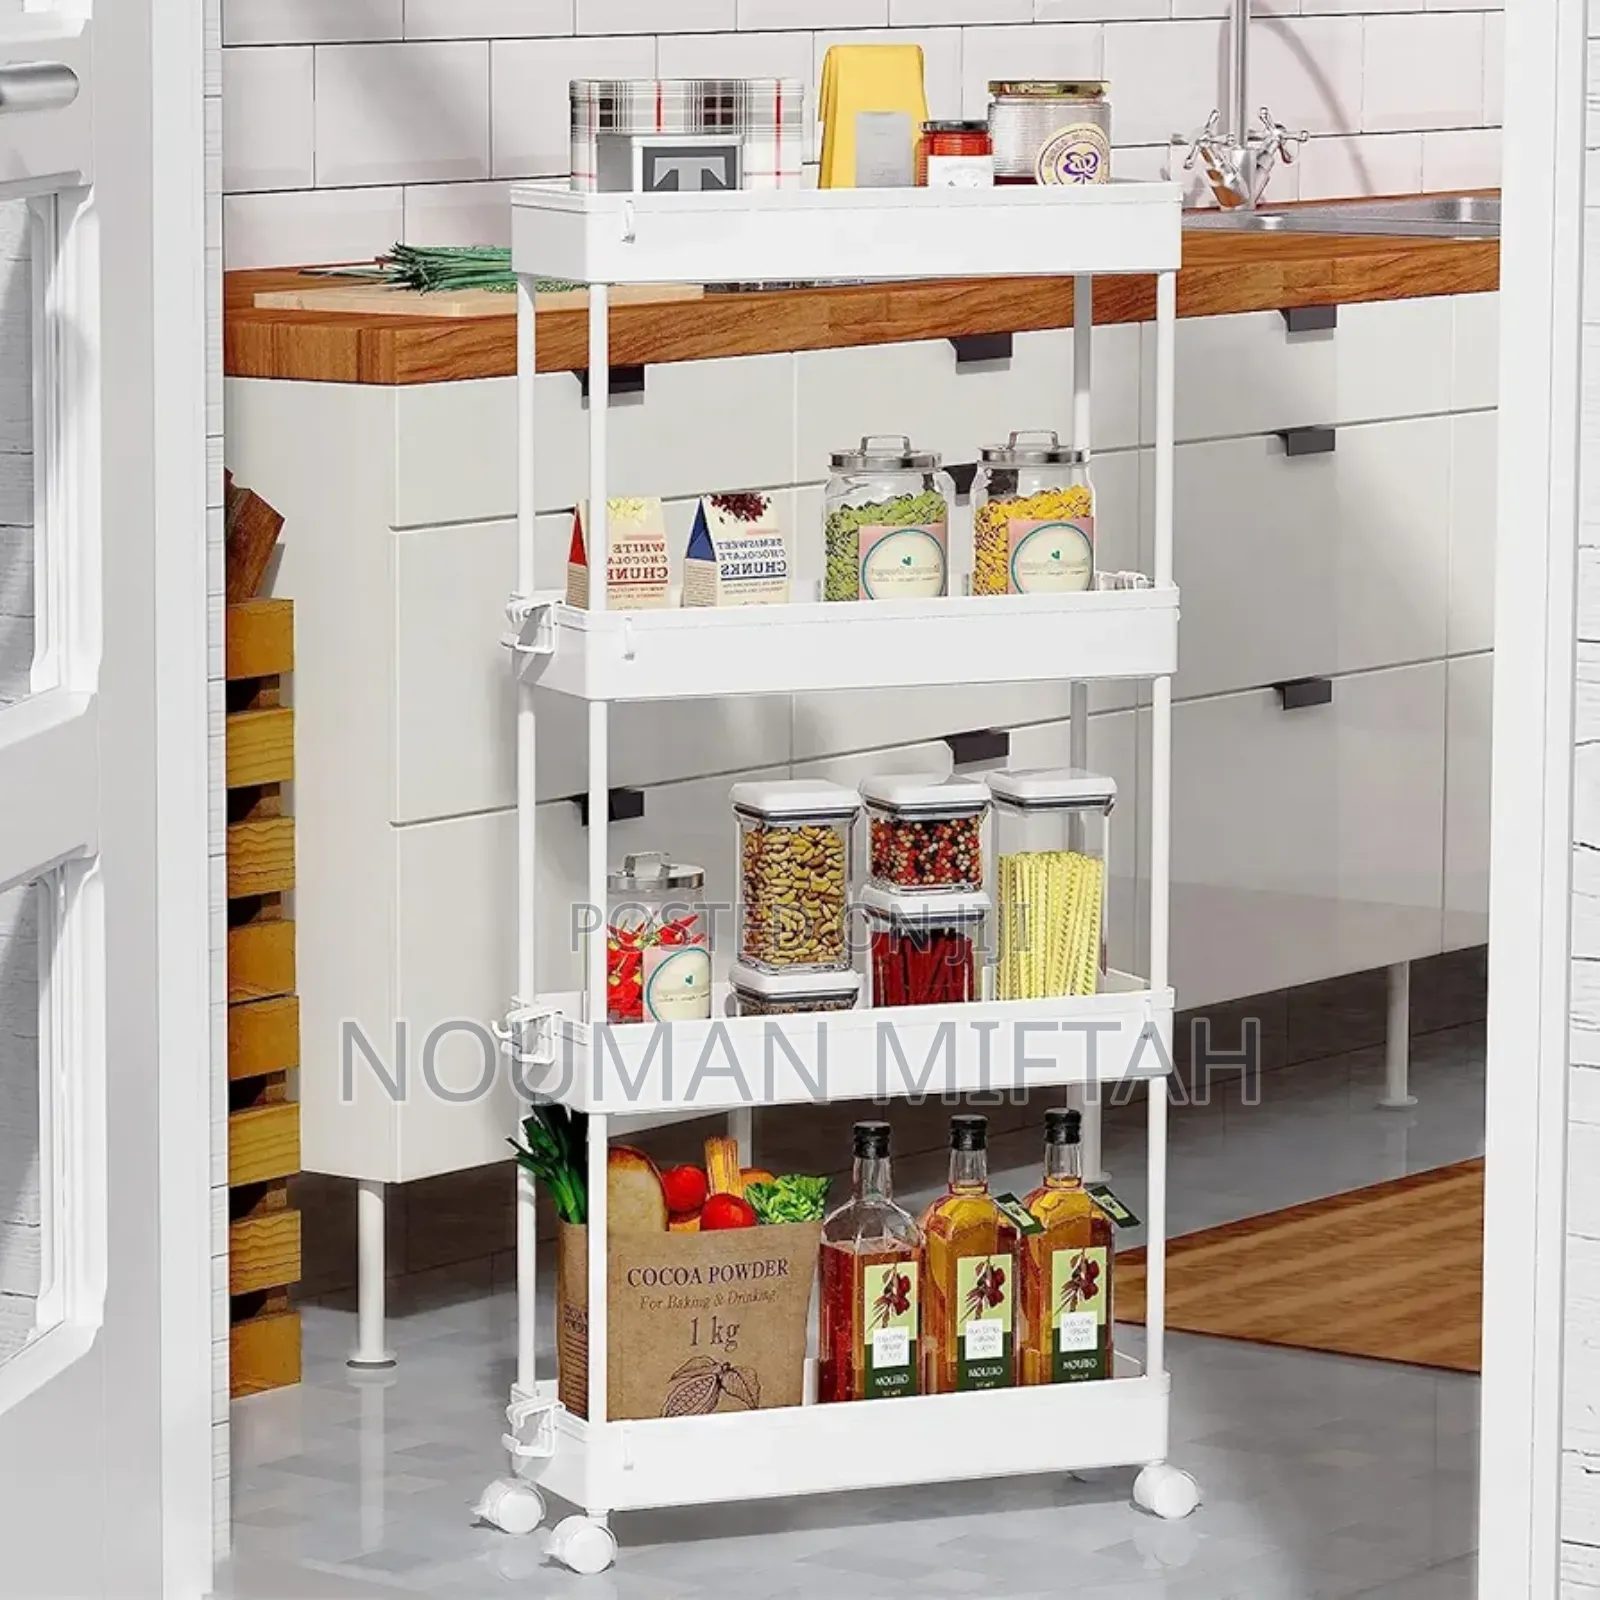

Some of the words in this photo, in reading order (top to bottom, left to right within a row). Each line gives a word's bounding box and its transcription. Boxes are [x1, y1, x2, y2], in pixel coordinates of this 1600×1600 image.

[627, 1267, 702, 1288] COCOA
[708, 1258, 788, 1283] POWDER
[640, 1296, 663, 1310] For
[690, 1316, 699, 1346] 1
[710, 1315, 740, 1352] kg
